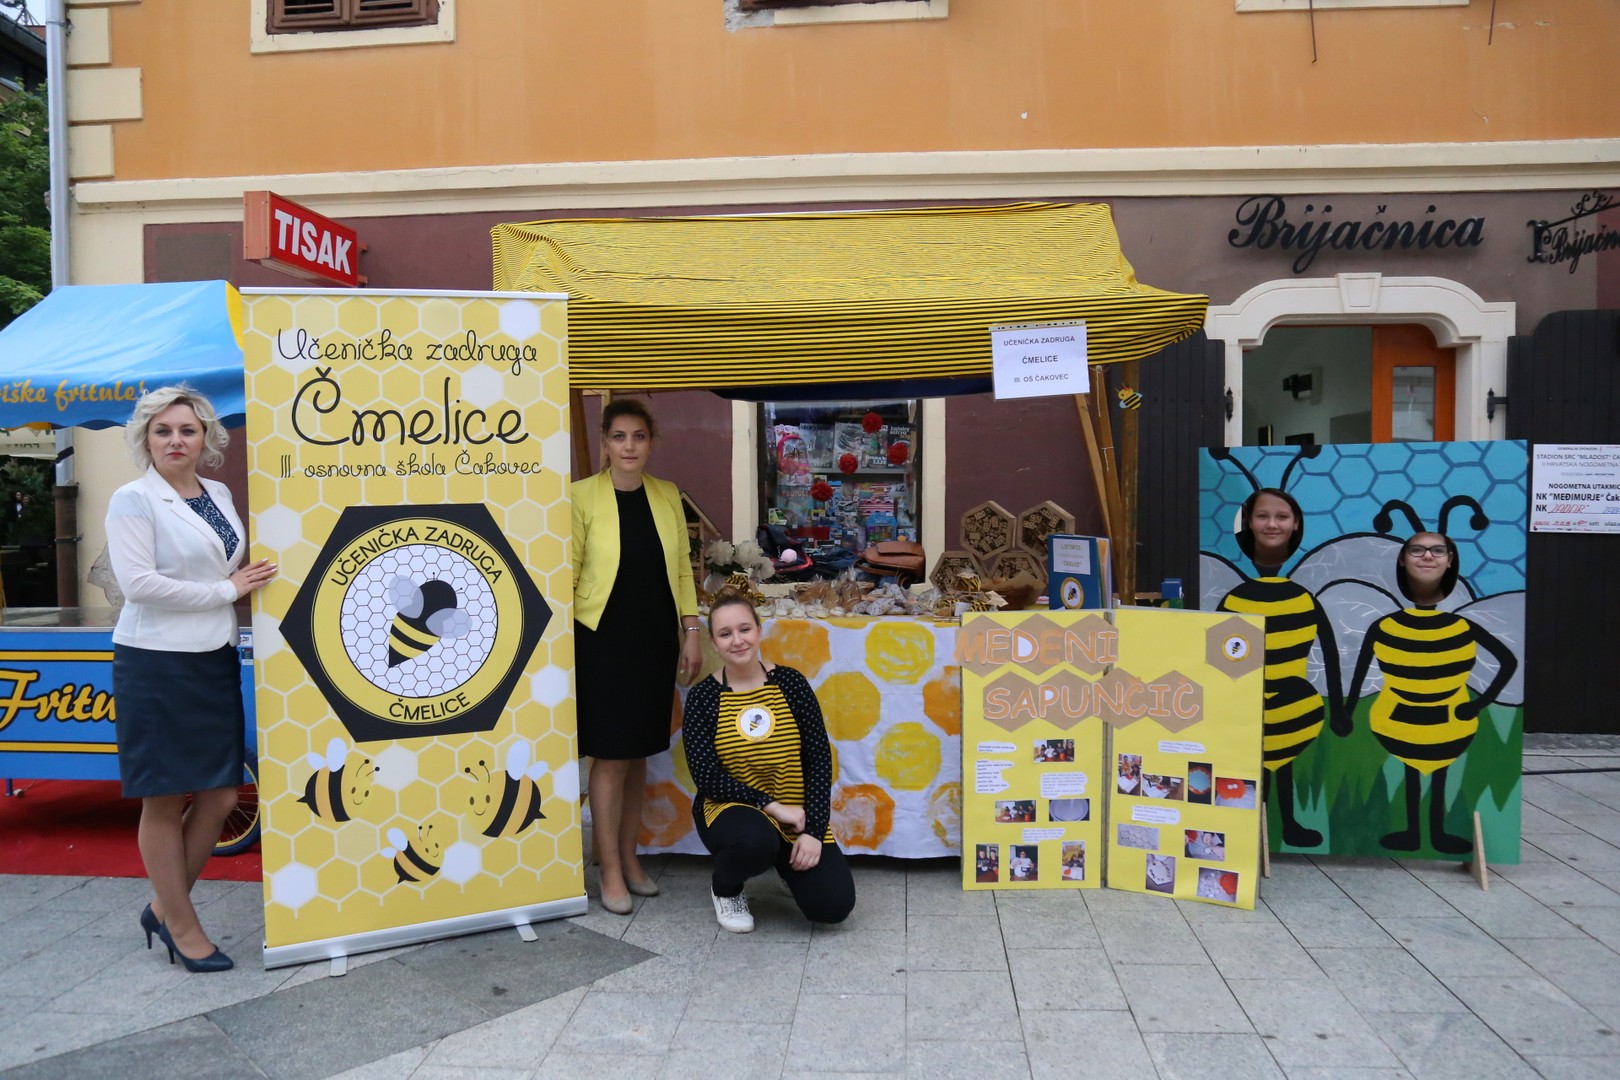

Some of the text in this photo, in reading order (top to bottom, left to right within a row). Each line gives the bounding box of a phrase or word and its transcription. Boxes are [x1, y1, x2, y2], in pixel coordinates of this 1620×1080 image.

[274, 208, 352, 275] TISAK
[1227, 193, 1485, 274] Brijačnica
[277, 328, 537, 376] Učenička zadruga
[1003, 335, 1076, 347] UČENIČKA ZADRUGA
[1021, 355, 1059, 365] ČMELICE
[1023, 375, 1034, 383] OŠ
[1034, 373, 1069, 382] ČAKOVEC
[291, 366, 529, 446] Čmelice
[304, 462, 387, 478] osnovna
[395, 453, 446, 477] škola
[454, 449, 542, 476] Čakovec
[1535, 504, 1548, 512] NK
[331, 526, 503, 587] UČENIČKA ZADRUGA
[952, 628, 1119, 665] MEDENI
[389, 692, 471, 720] ČMELICE
